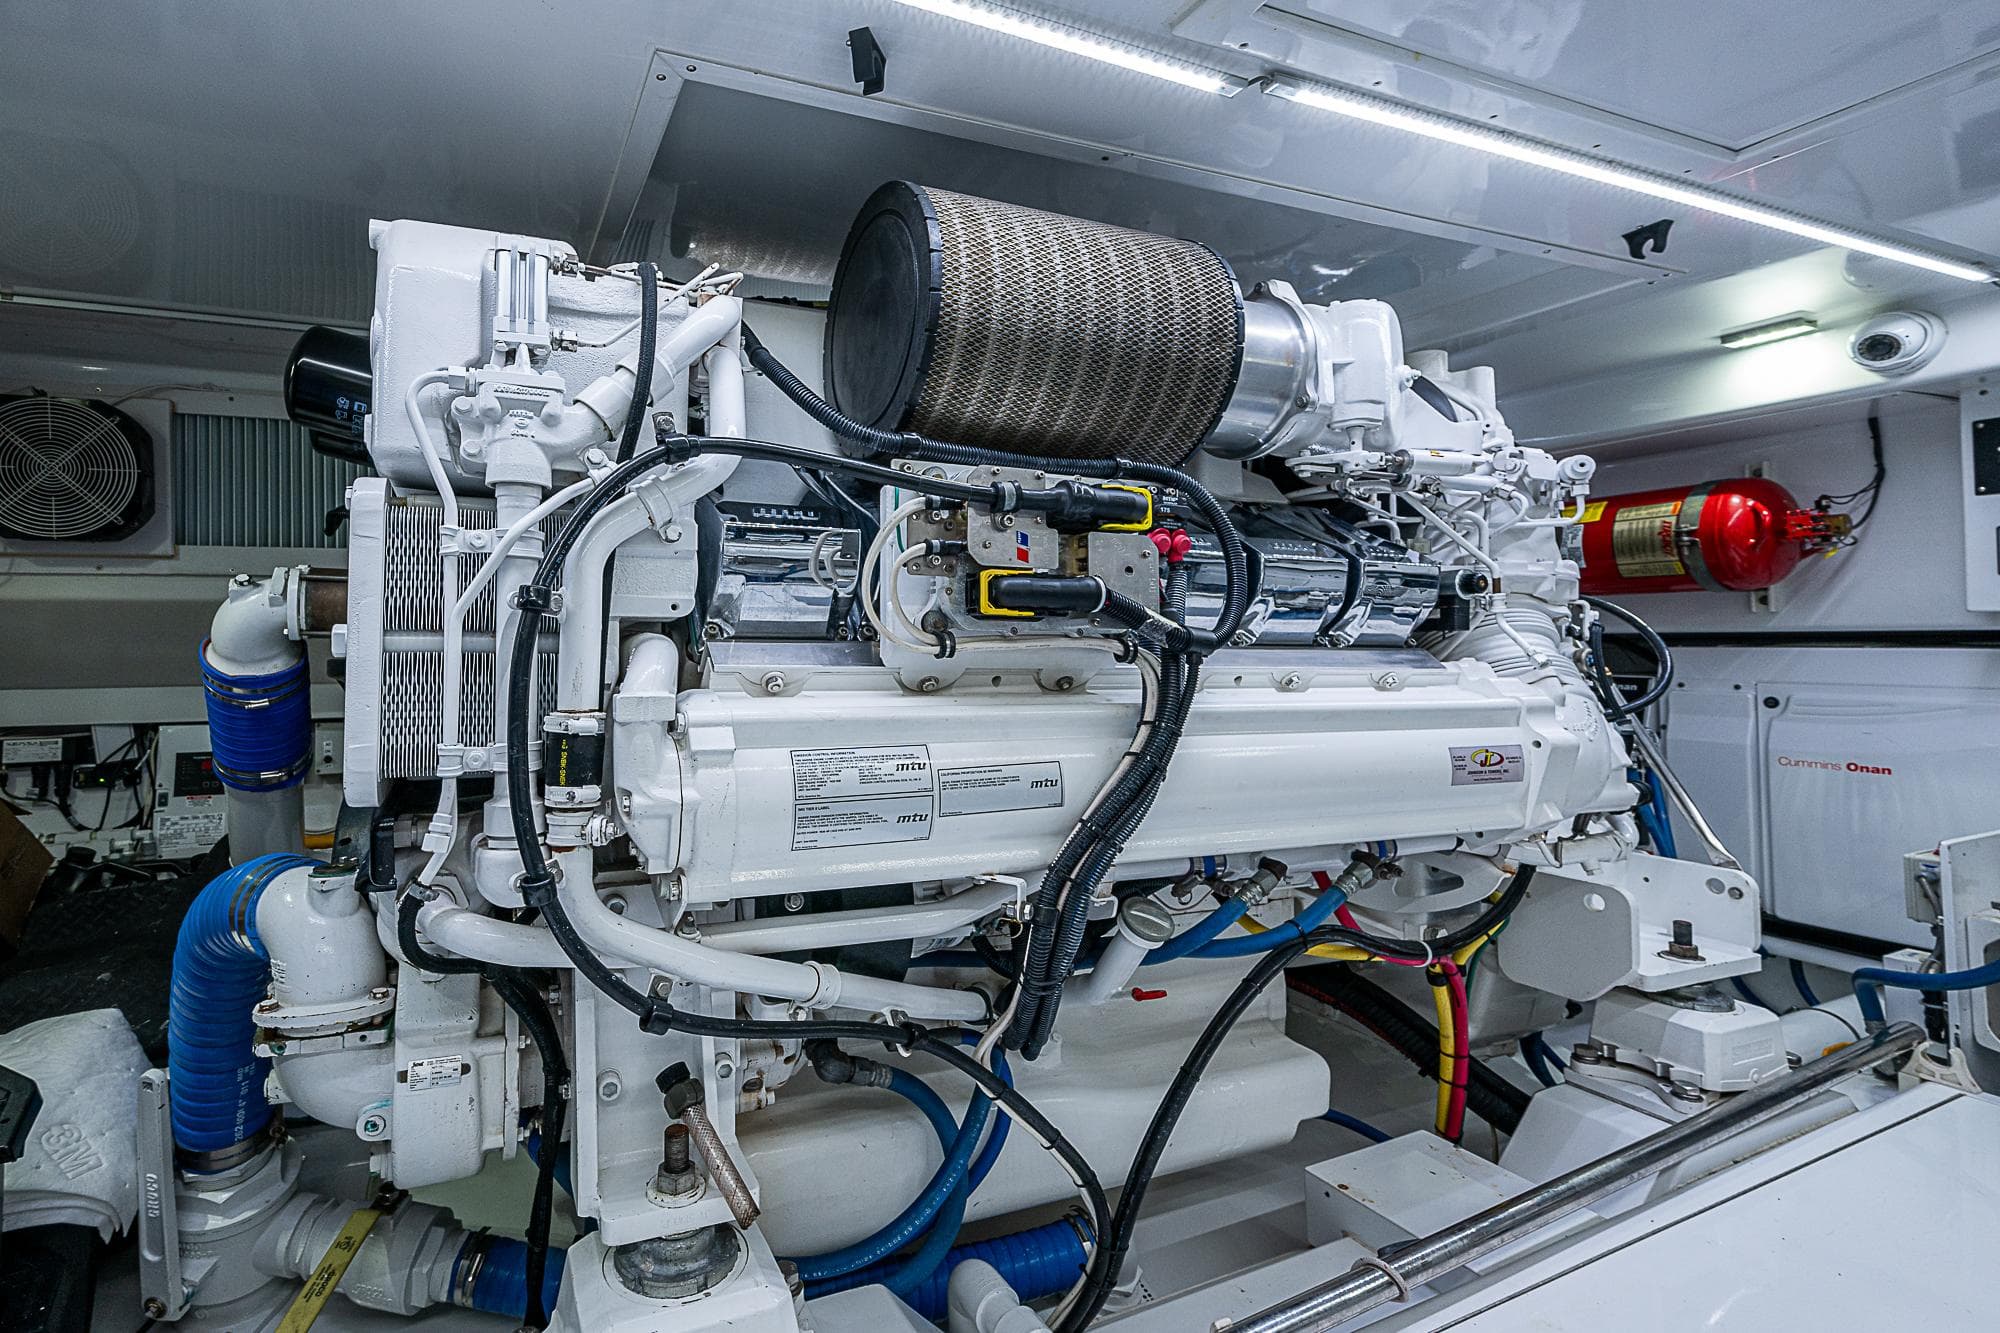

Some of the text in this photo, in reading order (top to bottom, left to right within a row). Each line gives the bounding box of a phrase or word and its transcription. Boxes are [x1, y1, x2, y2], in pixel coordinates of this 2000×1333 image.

[896, 761, 927, 772] mtu
[1778, 756, 1892, 775] Cummins Onan
[1030, 778, 1058, 789] mtu
[896, 813, 928, 824] mtu
[41, 1124, 103, 1180] 3M
